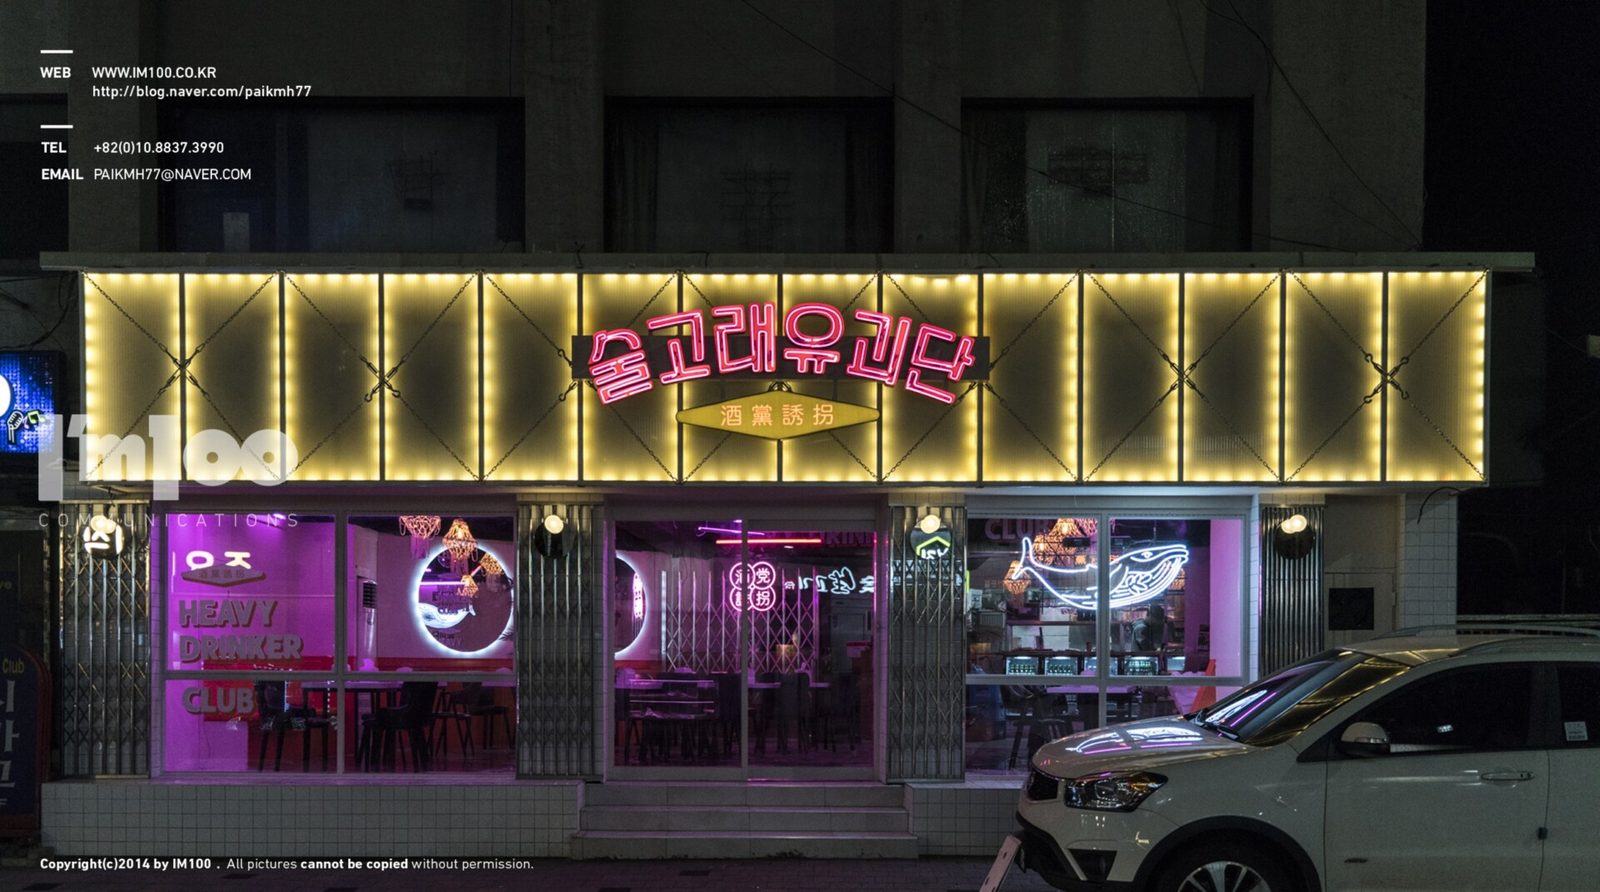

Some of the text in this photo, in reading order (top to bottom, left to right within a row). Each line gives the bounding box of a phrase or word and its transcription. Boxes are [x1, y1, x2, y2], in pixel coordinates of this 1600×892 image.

[178, 600, 278, 627] HEAVY
[179, 634, 304, 663] DRINKER
[181, 686, 256, 714] CLUB
